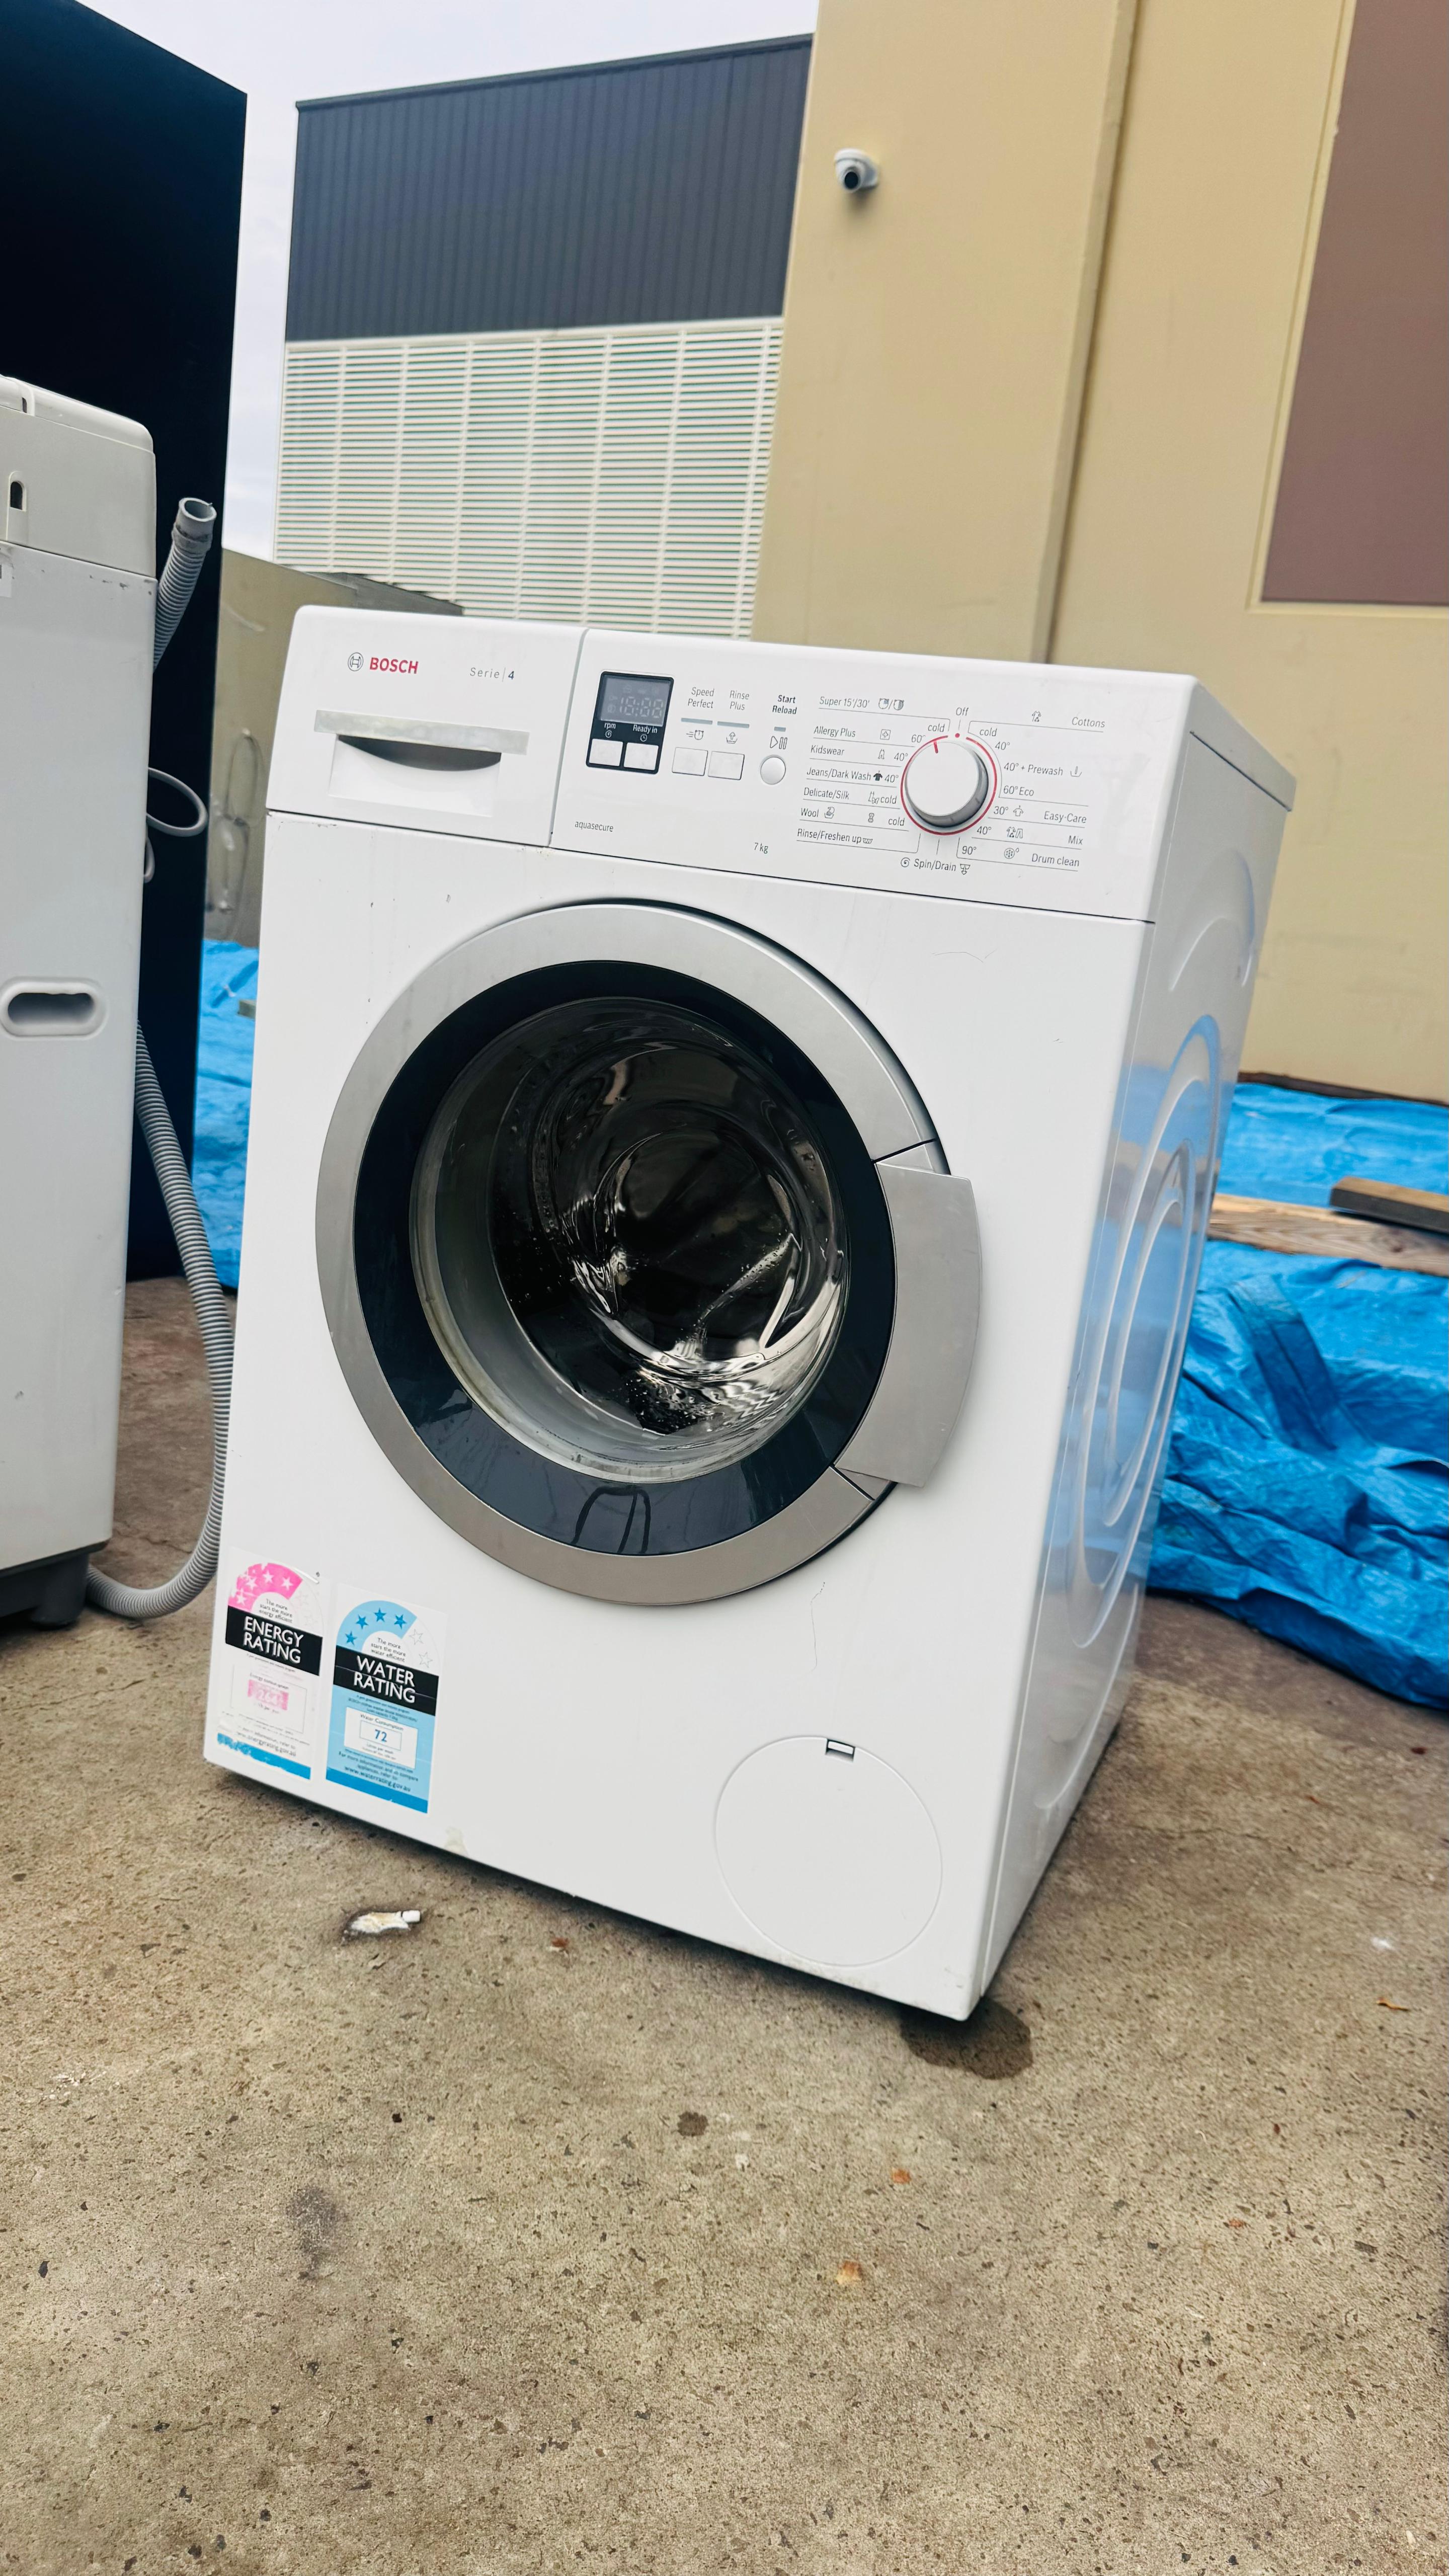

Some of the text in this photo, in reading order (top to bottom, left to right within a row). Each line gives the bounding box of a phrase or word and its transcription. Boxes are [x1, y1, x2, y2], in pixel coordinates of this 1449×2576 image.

[369, 657, 419, 674] BOSCH
[469, 668, 500, 679] Serie
[691, 687, 714, 698] Speed
[730, 690, 750, 700] Rinse
[688, 698, 713, 709] Perfect
[778, 695, 796, 704] Start
[820, 696, 841, 707] Super
[730, 701, 745, 710] Plus
[772, 705, 797, 714] Reload
[956, 707, 969, 716] Off
[928, 723, 945, 733] cold
[1072, 717, 1105, 728] Cottons
[633, 725, 651, 734] Ready
[814, 726, 856, 738] Allergy Plus
[980, 728, 997, 737] cold
[811, 745, 845, 756] Kidswear
[995, 741, 1010, 750] 40°
[894, 753, 909, 761] 40°
[807, 767, 871, 781] Jeans/Dark Wash
[1004, 763, 1019, 771] 40°
[1028, 765, 1064, 776] Prewash
[884, 774, 899, 783] 40°
[804, 787, 849, 799] Delicate/Silk
[1019, 787, 1034, 796] Eco
[880, 796, 897, 804] cold
[800, 808, 819, 818] Wool
[994, 806, 1009, 815] 30°
[889, 818, 905, 827] cold
[1044, 811, 1087, 824] Easy-Care
[575, 821, 613, 833] aquasecure
[977, 826, 992, 835] 40°
[797, 828, 861, 844] Rinse/Freshen up
[1068, 836, 1083, 845] Mix
[759, 843, 768, 854] kg
[962, 846, 977, 855] 90°
[914, 858, 956, 871] Spin/Drain
[1032, 853, 1080, 867] Drum clean
[244, 1616, 304, 1645] ENERGY
[243, 1634, 301, 1664] RATING
[356, 1655, 415, 1687] WATER
[353, 1671, 416, 1704] RATING
[374, 1729, 387, 1742] 72
